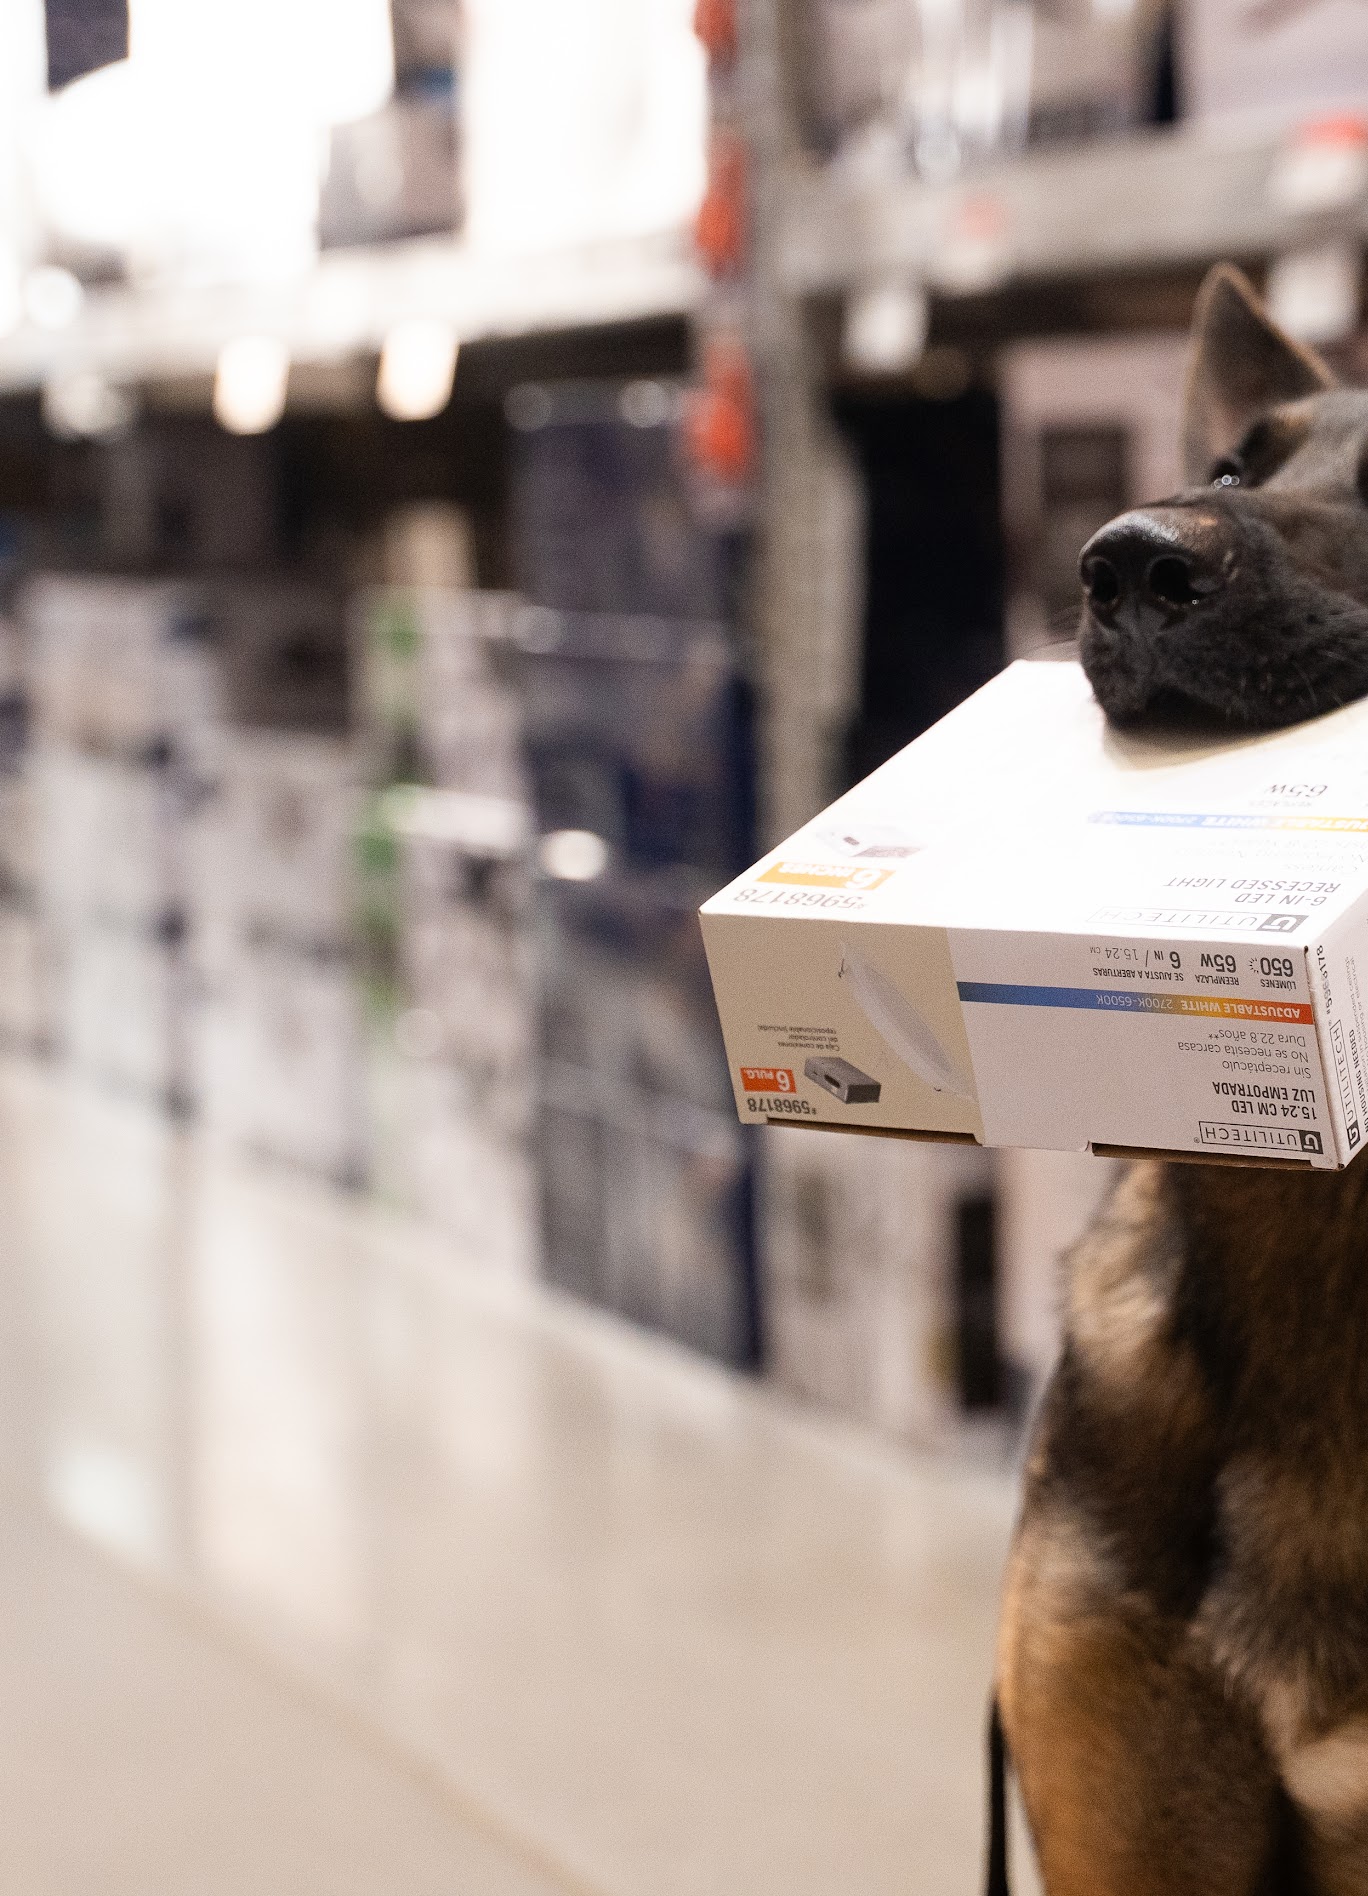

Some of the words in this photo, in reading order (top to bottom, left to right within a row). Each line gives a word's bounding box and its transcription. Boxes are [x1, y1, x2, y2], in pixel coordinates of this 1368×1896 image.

[1199, 815, 1268, 828] WHITE
[844, 868, 882, 889] 6
[1163, 876, 1228, 889] LIGHT
[1230, 878, 1341, 893] RECESSED
[1233, 892, 1276, 904] LED
[1278, 894, 1328, 907] 6-IN
[1095, 908, 1259, 928] UTILITECH
[1089, 946, 1101, 954] CM
[1104, 947, 1138, 961] 15.24
[1153, 950, 1164, 961] IN
[1144, 949, 1149, 967] /
[1169, 950, 1181, 970] 6
[1092, 967, 1136, 978] ABERTURAS
[1136, 970, 1143, 979] A
[1260, 957, 1293, 978] 650
[1144, 970, 1172, 981] AJUSTA
[1174, 972, 1184, 982] SE
[1194, 974, 1239, 986] REEMPLAZA
[1260, 978, 1297, 990] LÚMENES
[1095, 994, 1174, 1010] 2700K-6500K
[1180, 1000, 1221, 1013] WHITE
[1223, 1002, 1301, 1019] ADJUSTABLE
[1249, 1031, 1275, 1044] 22.8
[1277, 1033, 1306, 1047] Dura
[1177, 1041, 1221, 1053] carcasa
[1224, 1045, 1272, 1059] necesita
[1275, 1049, 1288, 1059] se
[1349, 1030, 1360, 1069] NEEDED
[1291, 1050, 1309, 1063] No
[1222, 1060, 1290, 1076] receptáculo
[1294, 1066, 1312, 1079] Sin
[775, 1070, 791, 1092] 6
[1334, 1029, 1354, 1122] UTILITECH
[1212, 1081, 1288, 1101] EMPOTRADA
[1291, 1088, 1316, 1103] LUZ
[1356, 1070, 1368, 1116] HOUSING
[1231, 1100, 1254, 1114] LED
[1257, 1102, 1277, 1116] CM
[1280, 1104, 1317, 1120] 15.24
[1205, 1126, 1298, 1146] UTILITECH
